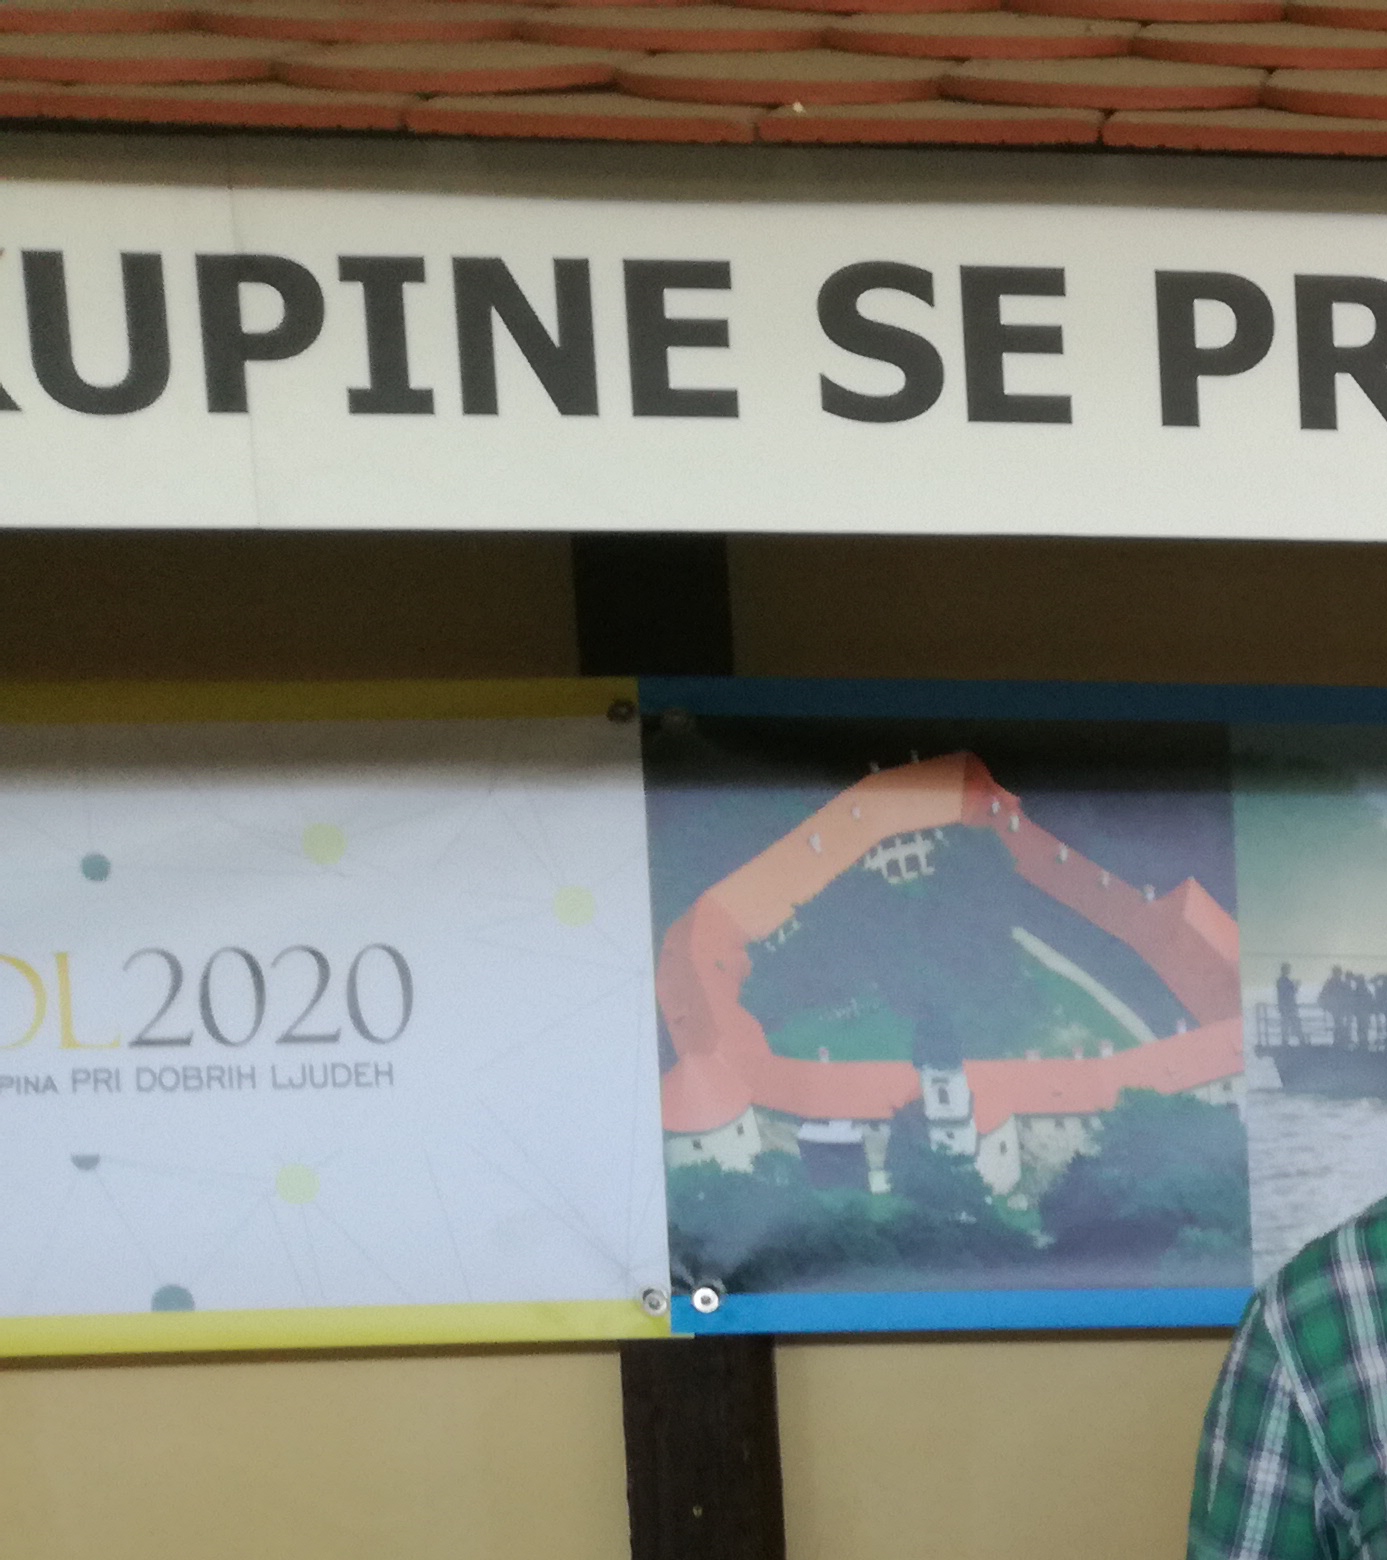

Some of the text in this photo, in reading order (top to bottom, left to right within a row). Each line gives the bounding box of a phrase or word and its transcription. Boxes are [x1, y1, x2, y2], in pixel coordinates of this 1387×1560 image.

[0, 250, 739, 419] UPINE
[816, 260, 1073, 425] SE
[70, 1066, 122, 1094] PRI
[136, 1064, 256, 1093] DOBRIH
[271, 1061, 395, 1091] LJUDEH
